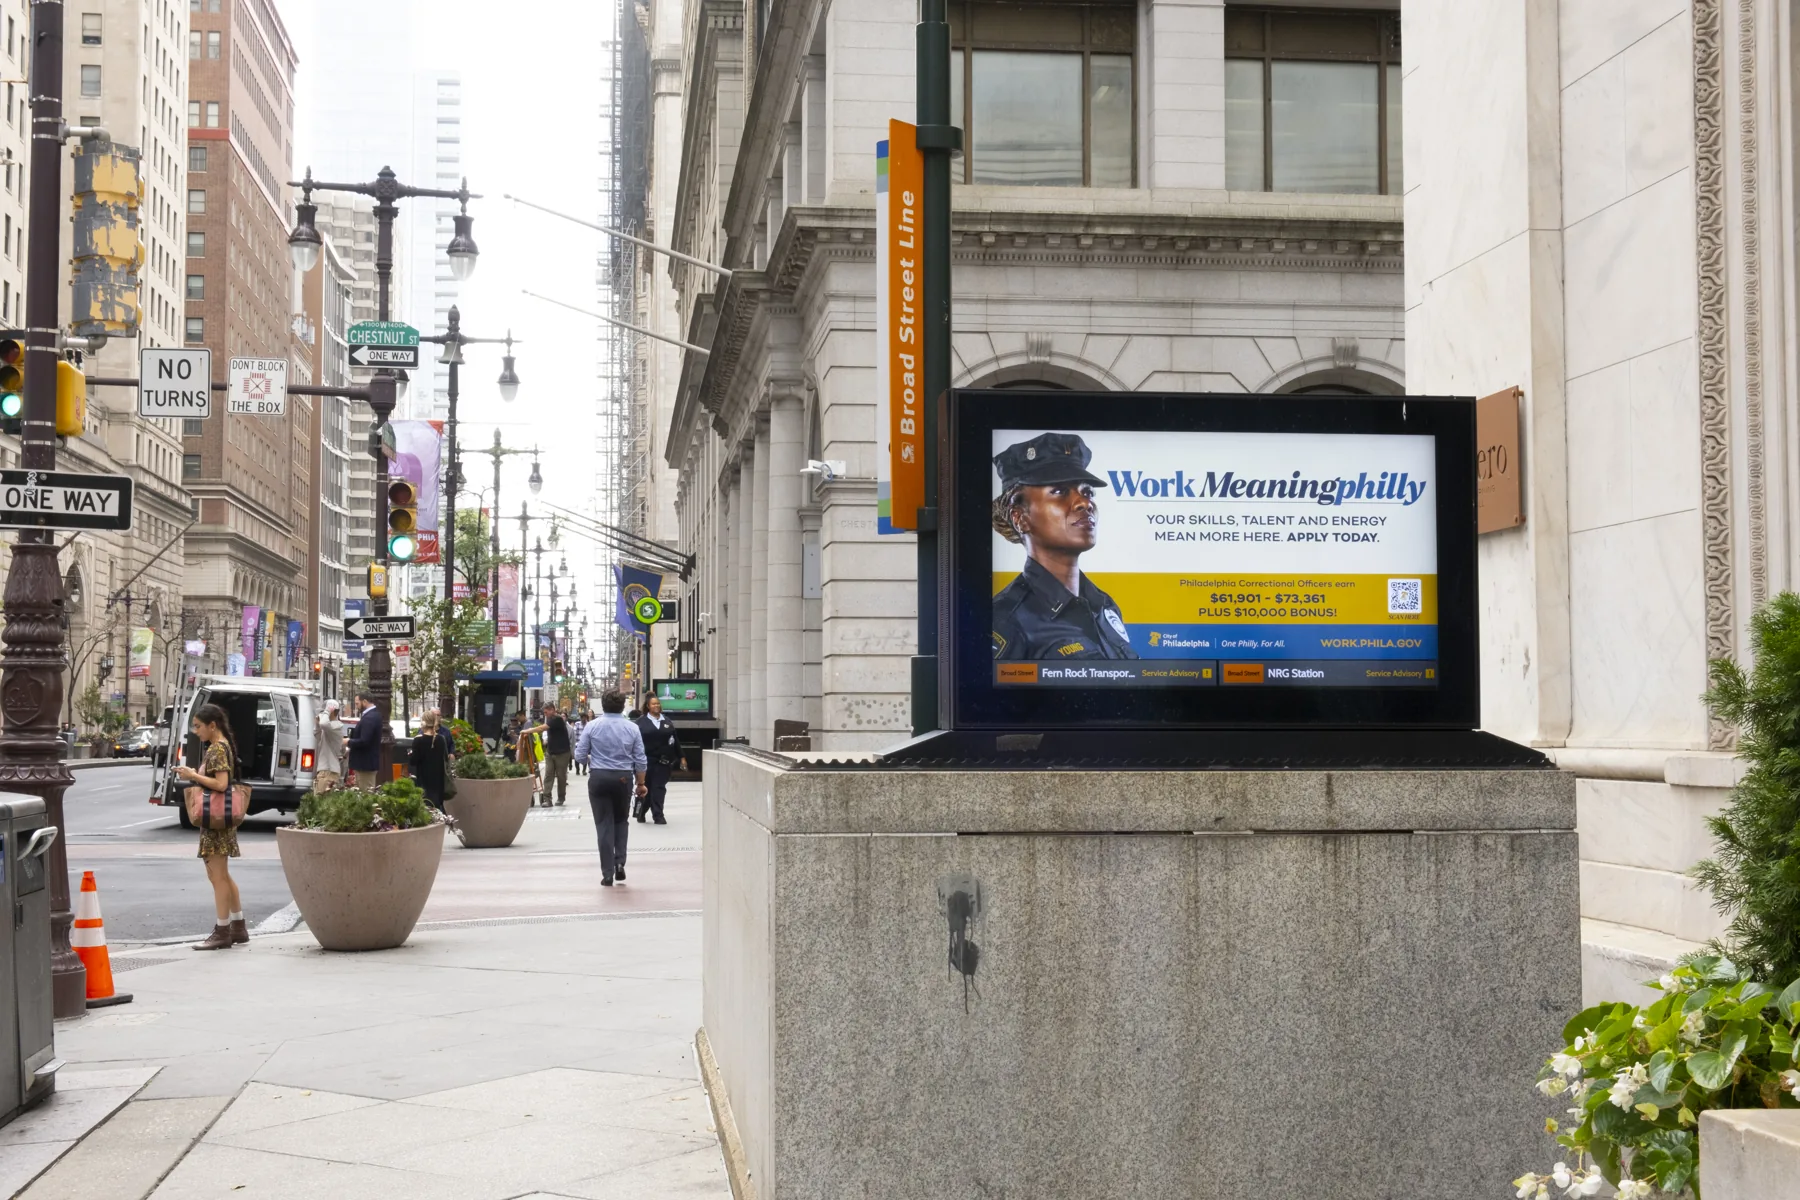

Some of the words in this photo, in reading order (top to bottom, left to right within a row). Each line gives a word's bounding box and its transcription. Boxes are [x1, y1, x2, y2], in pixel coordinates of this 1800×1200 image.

[898, 190, 915, 249] Line
[898, 257, 915, 345] Street
[350, 330, 405, 344] CHESTNUT
[409, 336, 418, 344] ST
[369, 351, 388, 360] ONE
[392, 351, 411, 360] WAY
[158, 358, 192, 380] NO
[257, 361, 284, 372] BLOCK
[144, 390, 206, 408] TURNS
[898, 353, 915, 435] Broad
[231, 400, 252, 412] THE
[257, 402, 281, 413] BOX
[1107, 470, 1196, 498] Work
[1198, 470, 1427, 506] Meaningphilly
[5, 487, 53, 510] ONE
[63, 490, 112, 512] WAY
[1146, 514, 1186, 525] YOUR
[1188, 515, 1239, 526] SKILLS,
[1242, 515, 1295, 526] TALENT
[1298, 516, 1328, 526] AND
[1332, 516, 1388, 526] ENERGY
[1154, 532, 1196, 542] MEAN
[1200, 532, 1240, 542] MORE
[1244, 532, 1284, 542] HERE.
[1287, 532, 1329, 542] APPLY
[1332, 532, 1380, 542] TODAY.
[1180, 579, 1236, 588] Philadelphia
[1238, 580, 1295, 588] Correctional
[1298, 580, 1332, 588] Officers
[1210, 593, 1261, 604] $61,901
[1275, 593, 1326, 605] $73,361
[1198, 608, 1231, 616] PLUS
[1234, 607, 1286, 618] $10,000
[1290, 608, 1337, 617] BONUS!
[364, 624, 384, 632] ONE
[387, 623, 407, 632] WAY
[1058, 642, 1084, 656] YOUNG
[1162, 640, 1210, 648] Philadelphia
[1238, 640, 1259, 650] Philly.
[1320, 639, 1422, 648] WORK.PHILA.GOV
[1042, 668, 1062, 678] Fern
[1064, 668, 1089, 678] Rock
[1169, 670, 1200, 678] Advisory
[1268, 668, 1290, 678] NRG
[1291, 668, 1324, 678] Station
[1392, 670, 1422, 678] Advisory
